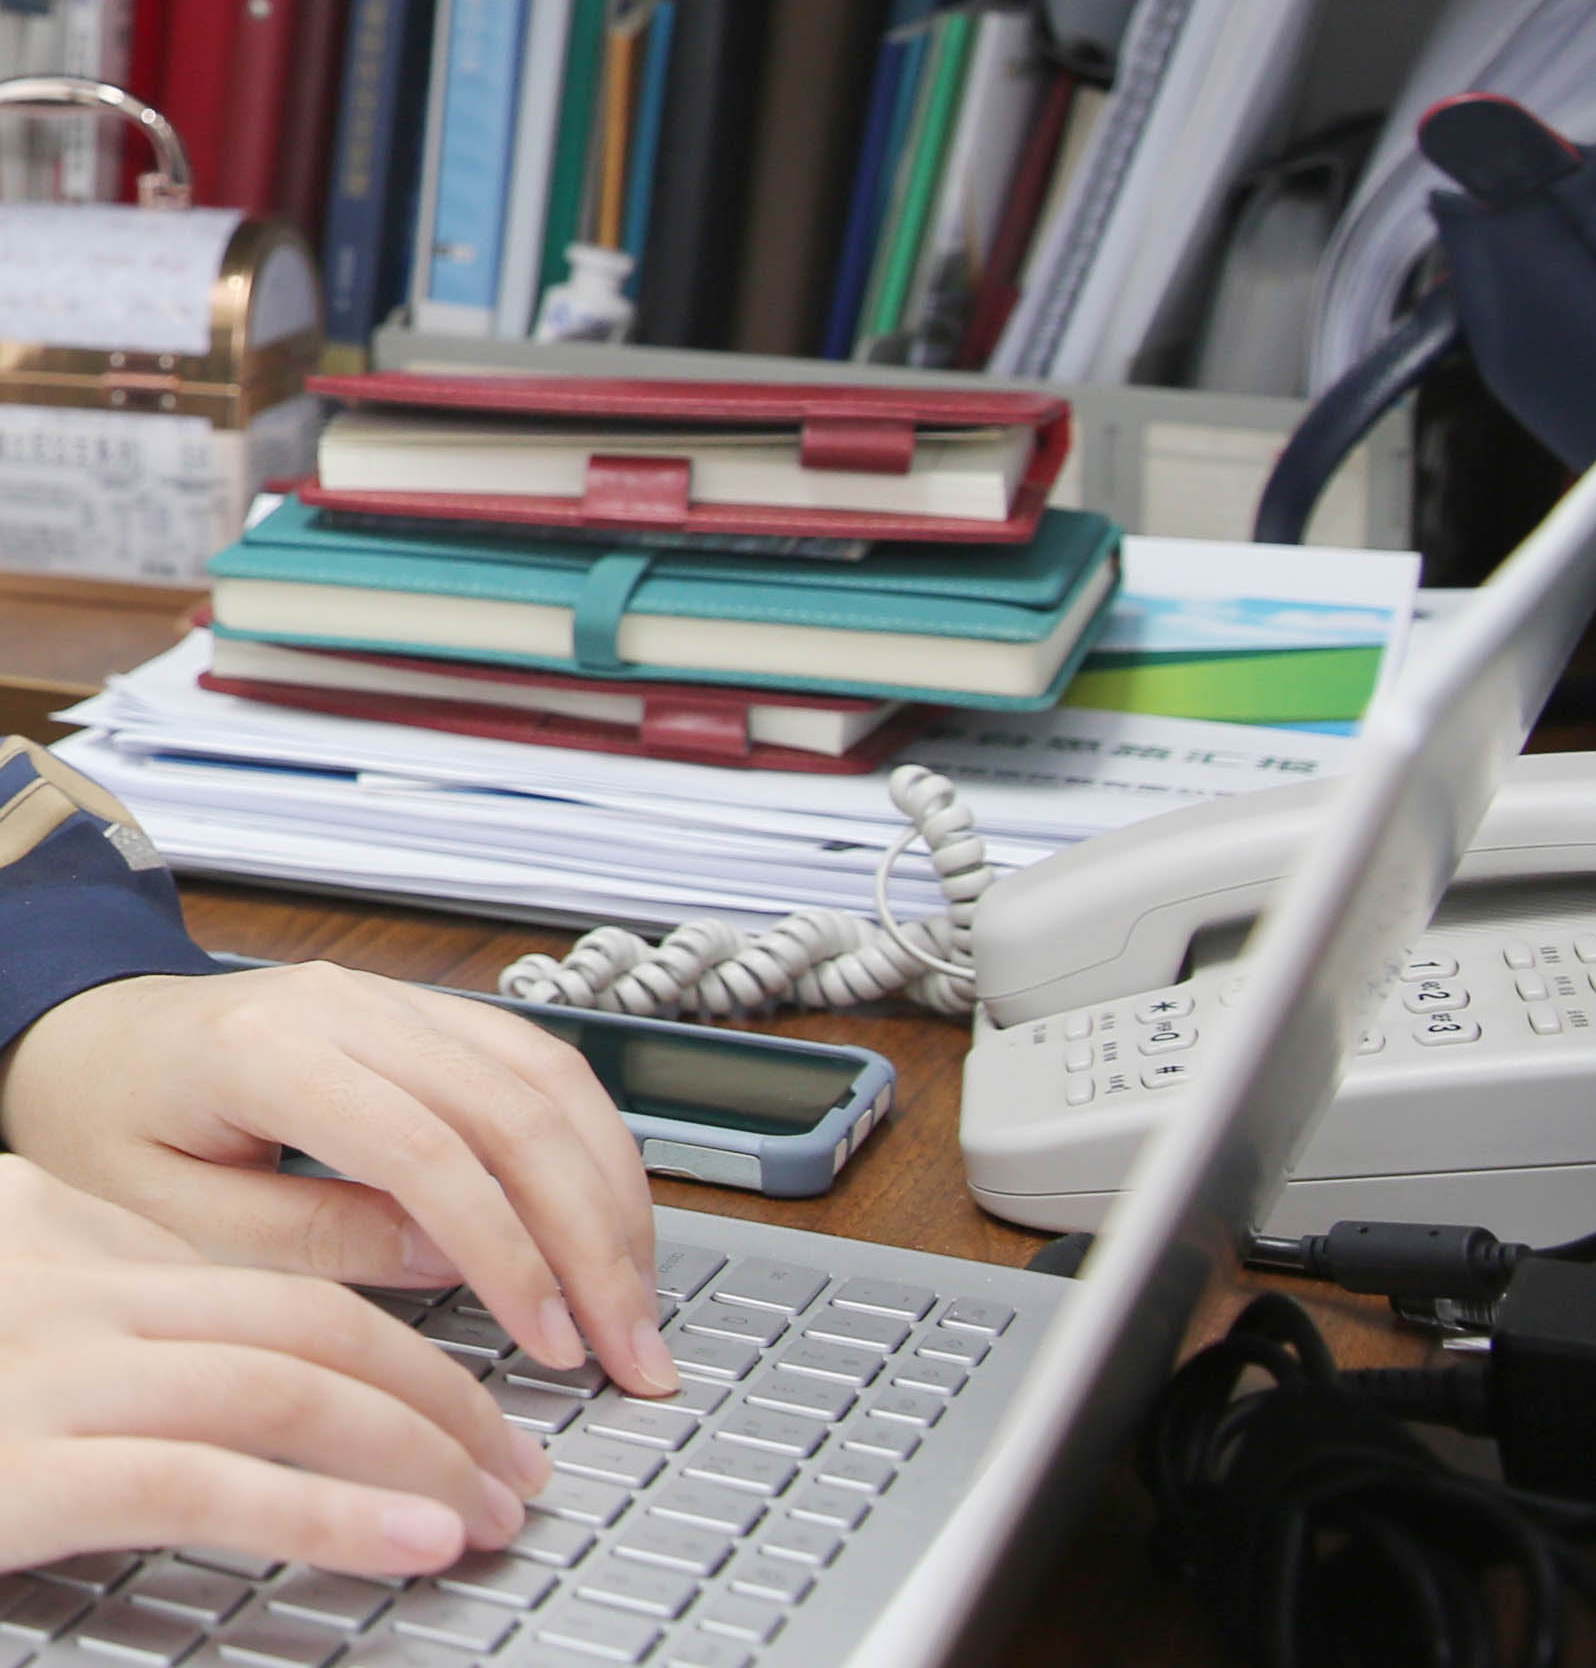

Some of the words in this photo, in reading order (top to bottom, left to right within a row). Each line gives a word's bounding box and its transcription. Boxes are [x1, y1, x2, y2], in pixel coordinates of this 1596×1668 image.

[1409, 960, 1440, 969] 1
[1418, 991, 1451, 1002] 2
[1427, 1023, 1462, 1034] 3
